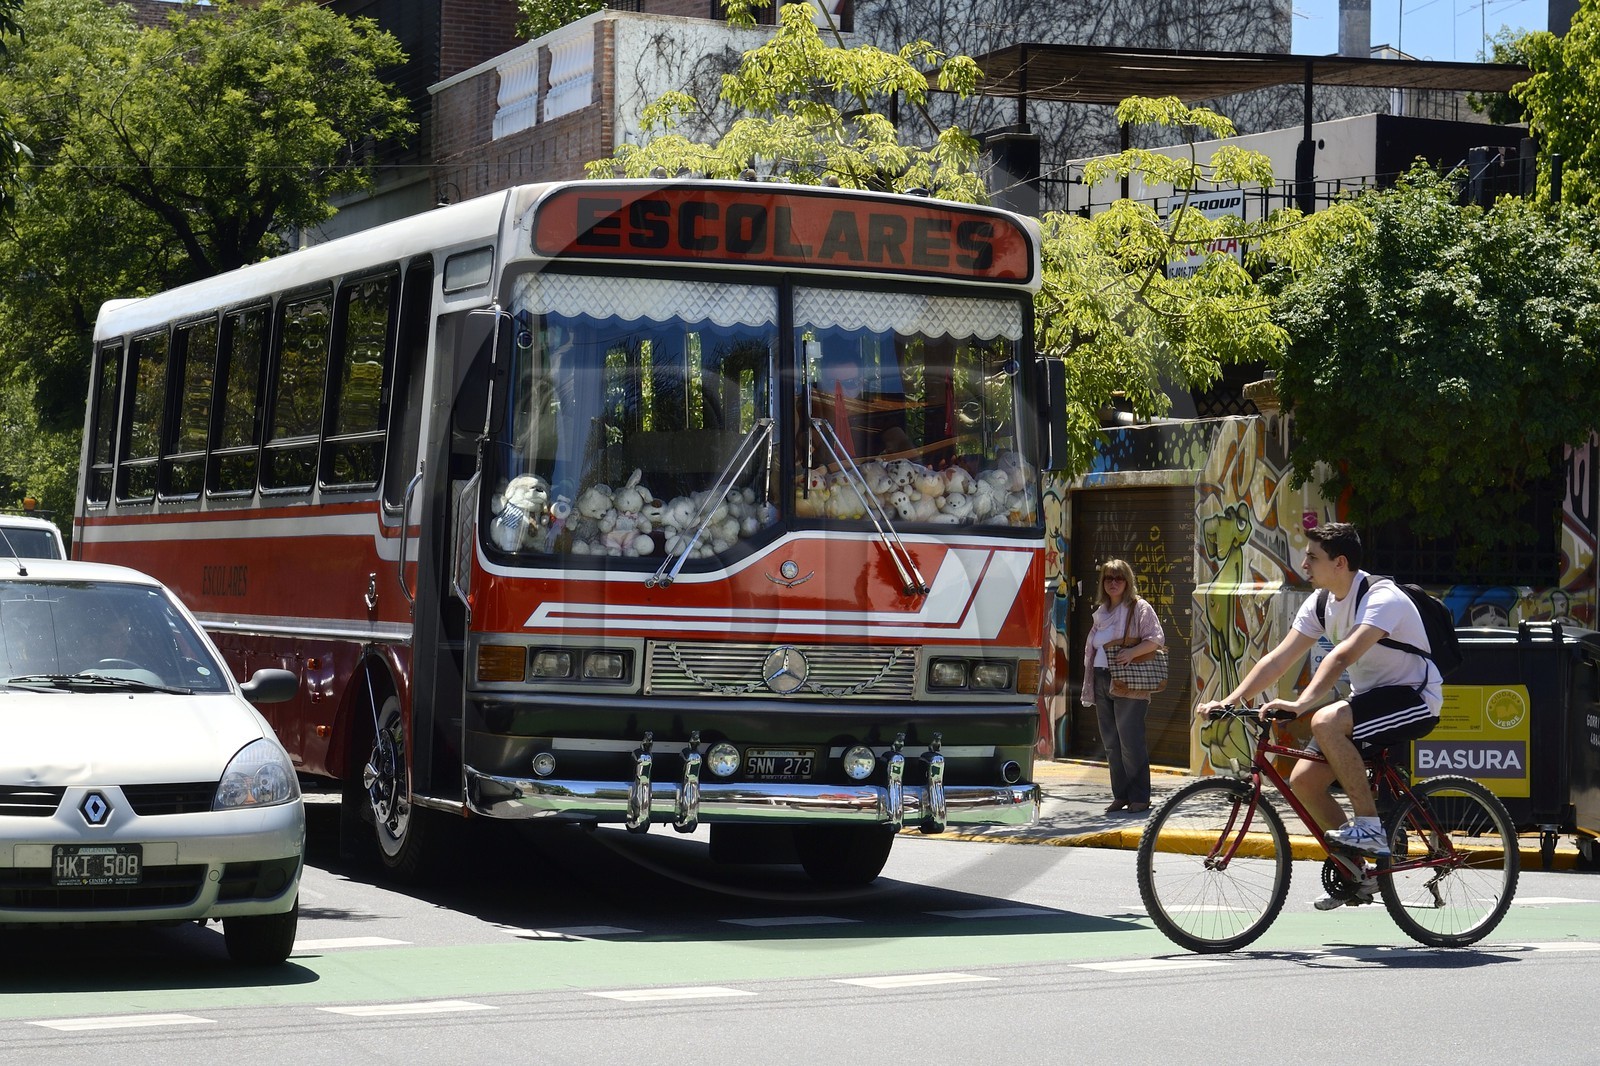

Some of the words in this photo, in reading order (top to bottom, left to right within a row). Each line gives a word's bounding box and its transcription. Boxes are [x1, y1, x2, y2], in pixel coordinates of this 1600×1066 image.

[1189, 197, 1241, 211] GROUP
[576, 198, 994, 269] ESCOLARES
[202, 565, 248, 597] ESCOLARES
[1491, 691, 1517, 704] CIUDAD
[1497, 715, 1520, 727] VERDE
[748, 757, 775, 774] SNN
[783, 758, 812, 775] 273
[1418, 749, 1522, 770] BASURA
[56, 855, 91, 877] HKI
[103, 855, 139, 876] 508
